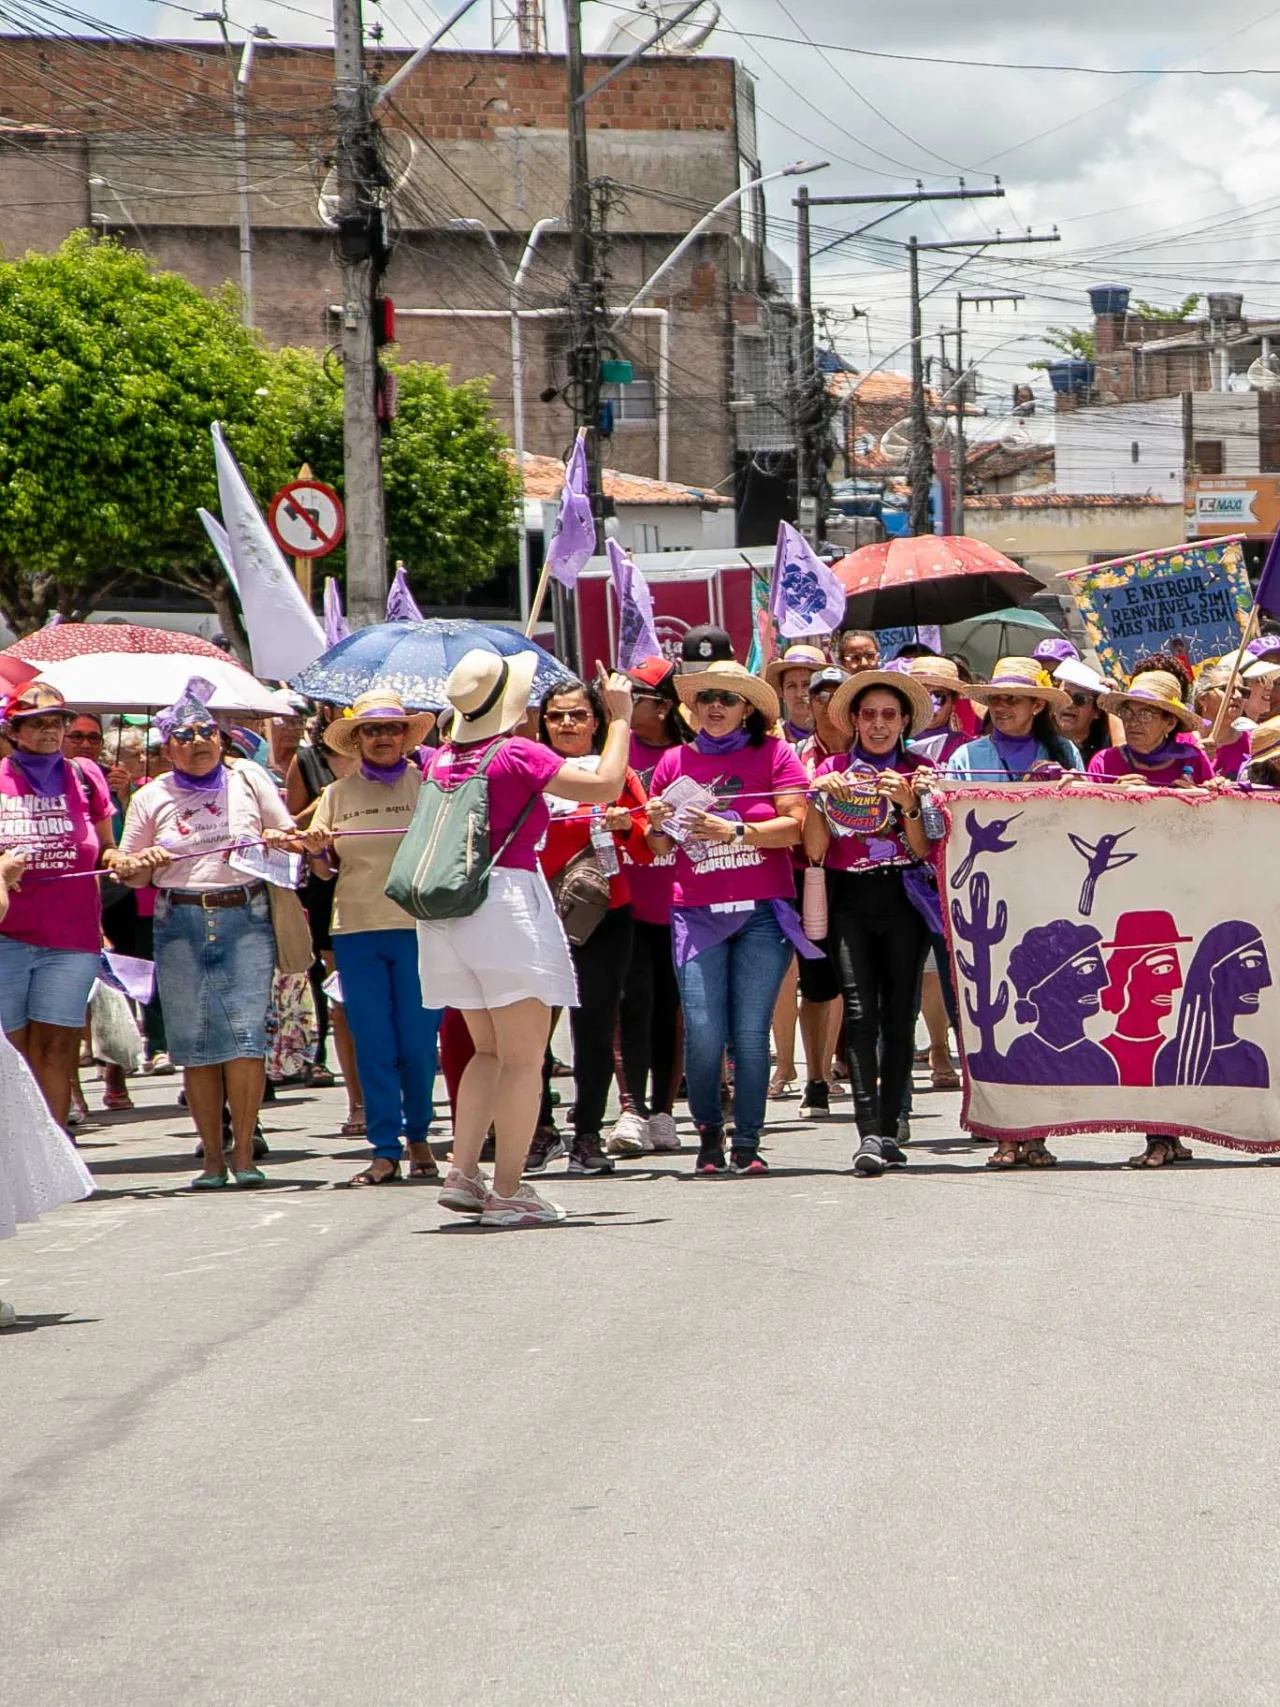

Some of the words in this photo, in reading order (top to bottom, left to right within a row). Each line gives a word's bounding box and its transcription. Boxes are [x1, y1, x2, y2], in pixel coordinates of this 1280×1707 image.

[1124, 575, 1205, 604] ENERGIA
[1111, 598, 1194, 623] RENOVÁVEL
[1198, 589, 1230, 608] SIM!
[1112, 620, 1143, 639] MAS
[1146, 614, 1174, 631] NÃO
[1182, 605, 1235, 627] ASSIM!
[0, 815, 74, 835] ERRITÓRIO
[831, 809, 876, 828] RESPEITO
[43, 850, 77, 860] LUGAR
[695, 852, 763, 875] AGROECOLÓGICA
